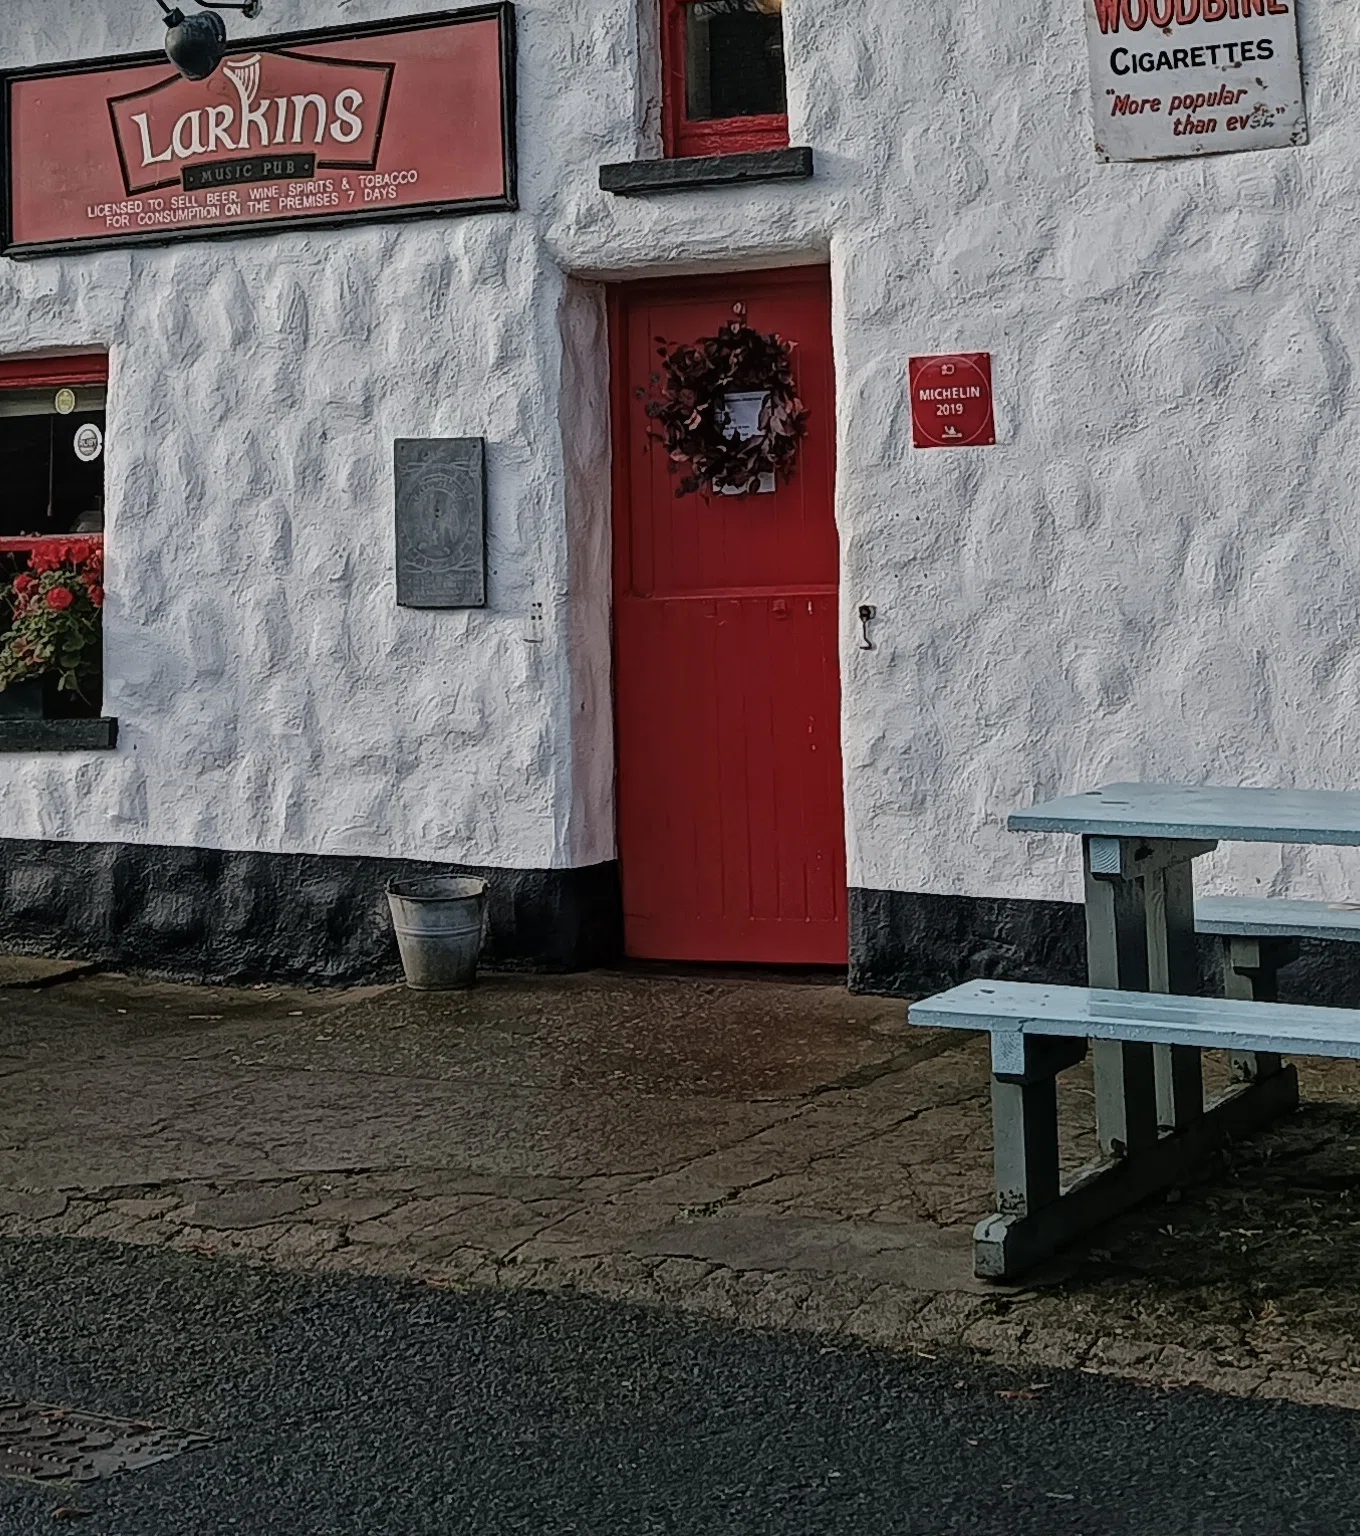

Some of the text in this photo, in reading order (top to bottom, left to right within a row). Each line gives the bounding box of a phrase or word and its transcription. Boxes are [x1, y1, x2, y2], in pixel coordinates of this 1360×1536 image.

[1110, 38, 1274, 75] CIGARETTES
[1168, 84, 1248, 115] popular
[1173, 114, 1217, 136] than
[201, 161, 295, 183] MUSIC PUB
[87, 200, 143, 218] LICENSED
[148, 198, 164, 211] TO
[170, 195, 198, 209] SELL
[289, 179, 334, 196] SPIRITS
[341, 177, 350, 190] &
[358, 170, 418, 188] TOBACCO
[106, 186, 397, 228] FOR CONSUMPTION ON THE PREMISES 7 DAYS
[920, 386, 980, 400] MICHELIN
[936, 404, 964, 415] 2019
